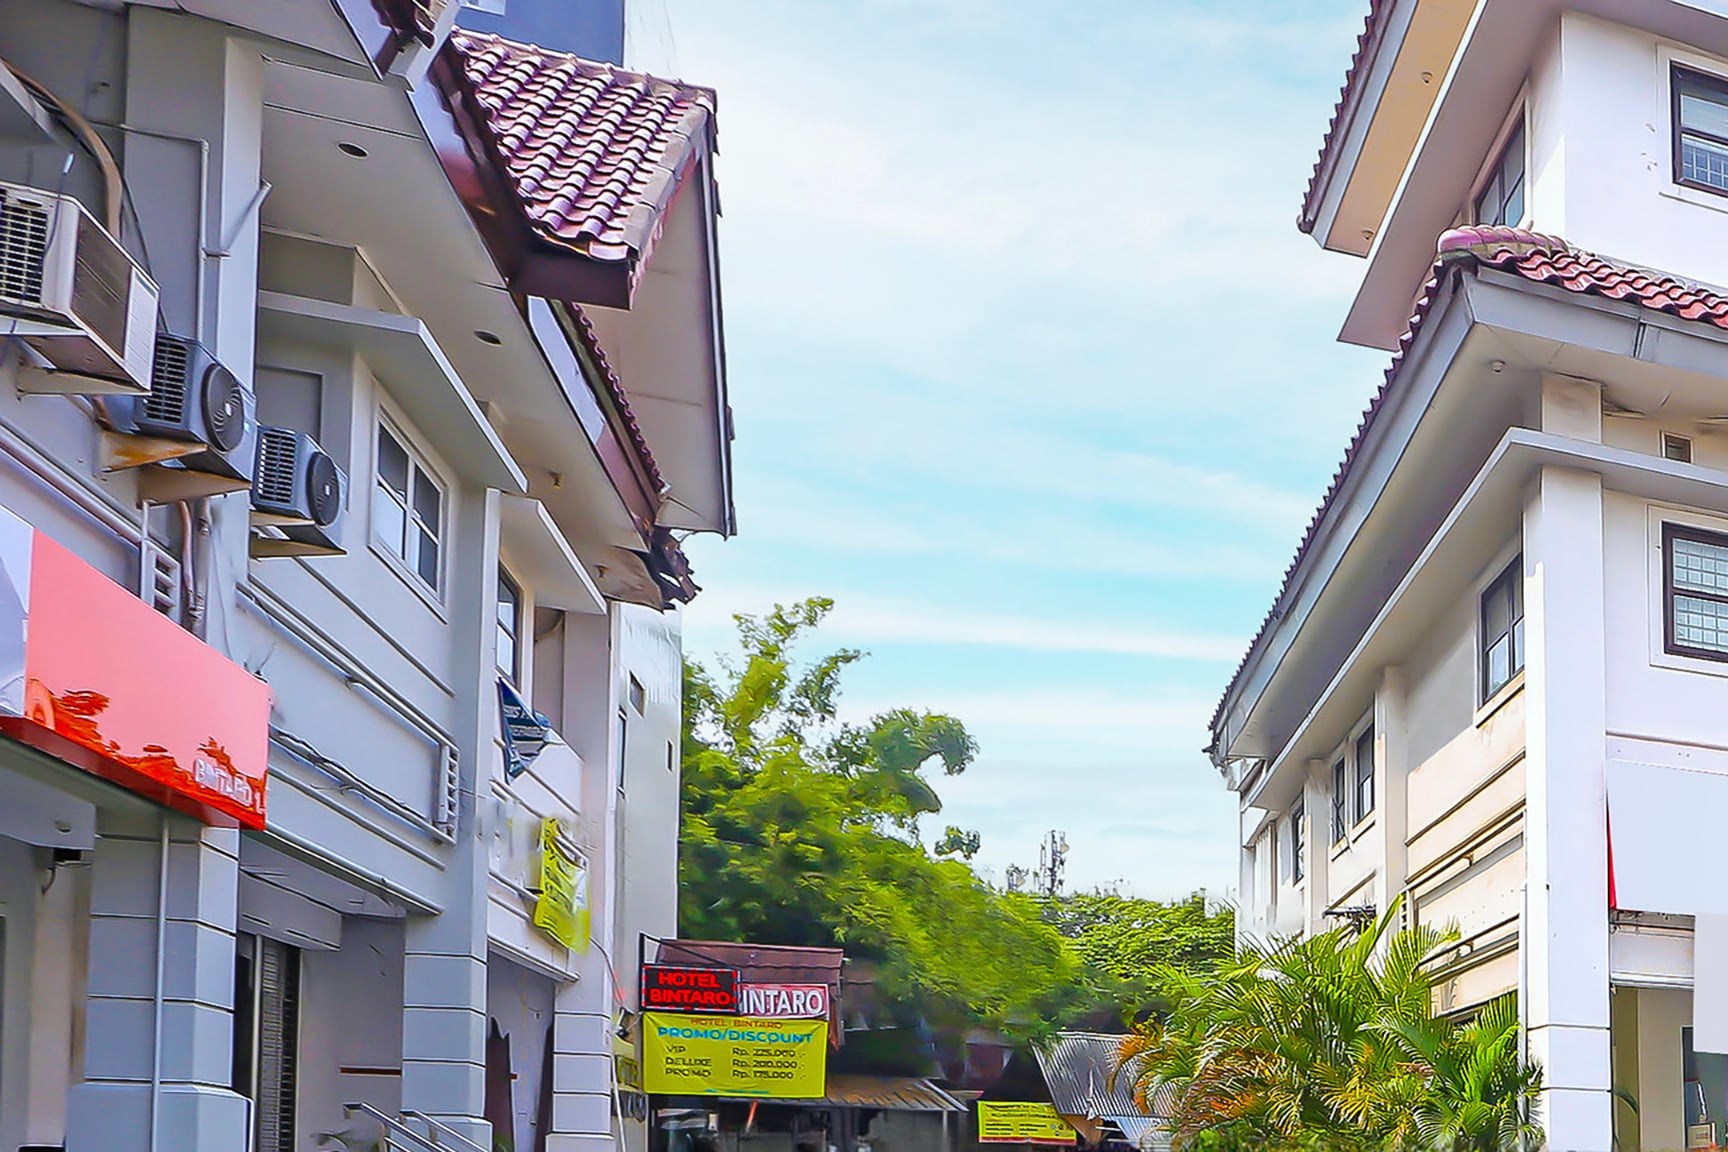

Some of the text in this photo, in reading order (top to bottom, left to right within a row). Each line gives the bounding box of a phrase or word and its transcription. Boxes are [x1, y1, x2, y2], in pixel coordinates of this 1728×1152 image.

[658, 971, 720, 988] HOTEL
[650, 988, 731, 1006] BINTARO
[738, 989, 823, 1015] INTARO
[690, 1018, 784, 1029] HOTEL BINTARO
[657, 1027, 814, 1043] PROMO/DISCOUNT
[666, 1045, 686, 1053] VIP
[665, 1056, 712, 1066] DELUXE
[665, 1068, 712, 1077] PROMO
